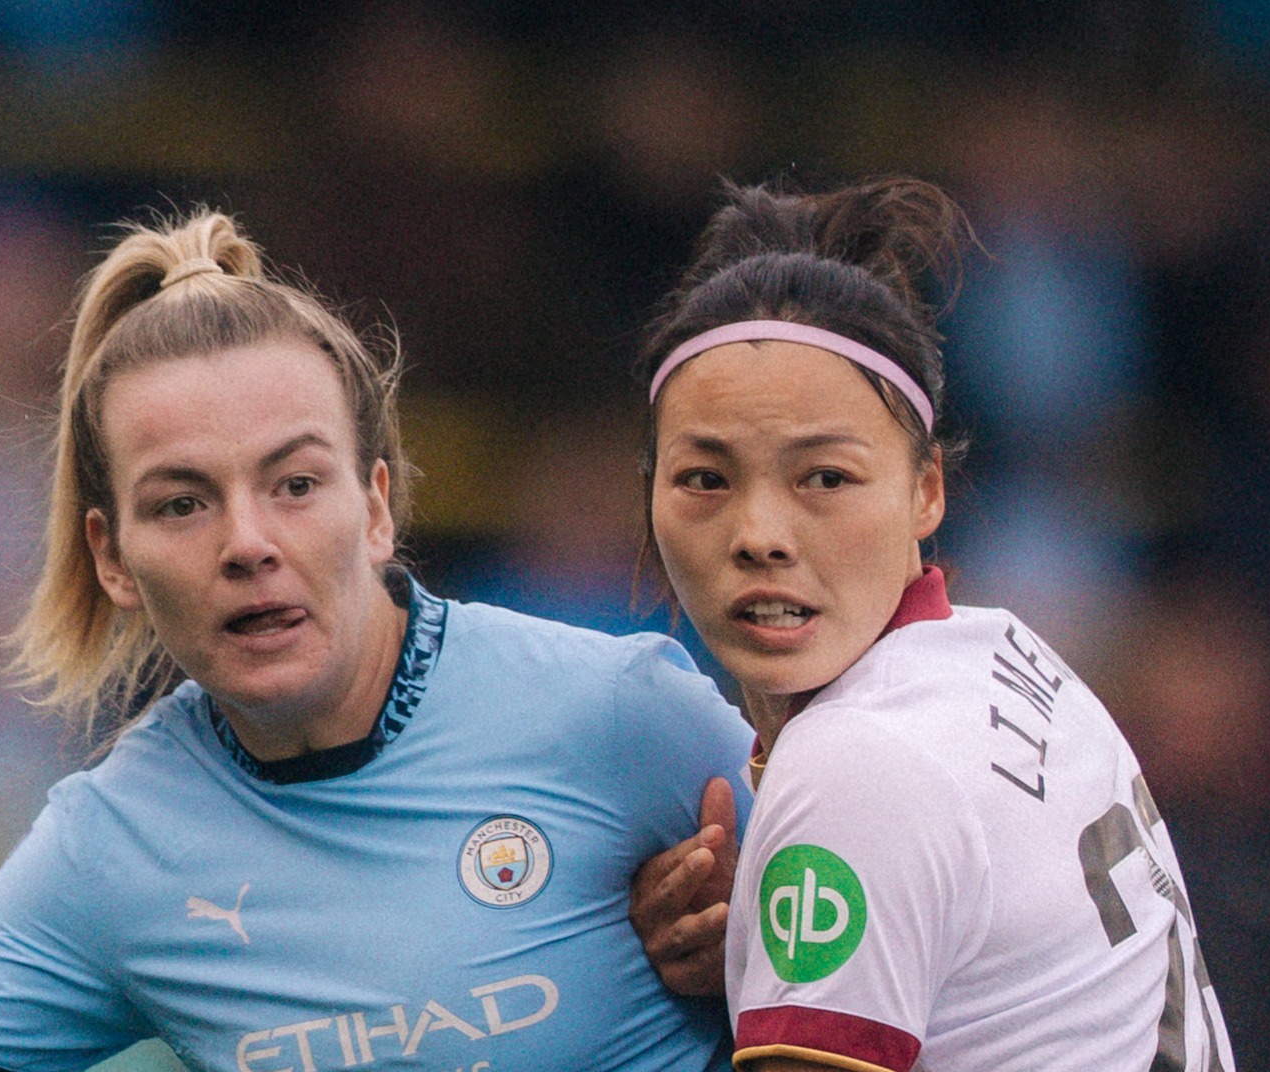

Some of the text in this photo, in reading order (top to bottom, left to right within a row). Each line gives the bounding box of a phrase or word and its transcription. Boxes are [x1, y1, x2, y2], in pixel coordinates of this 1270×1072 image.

[465, 820, 540, 857] MANCHESTER
[495, 890, 524, 903] CITY
[769, 867, 850, 960] qb
